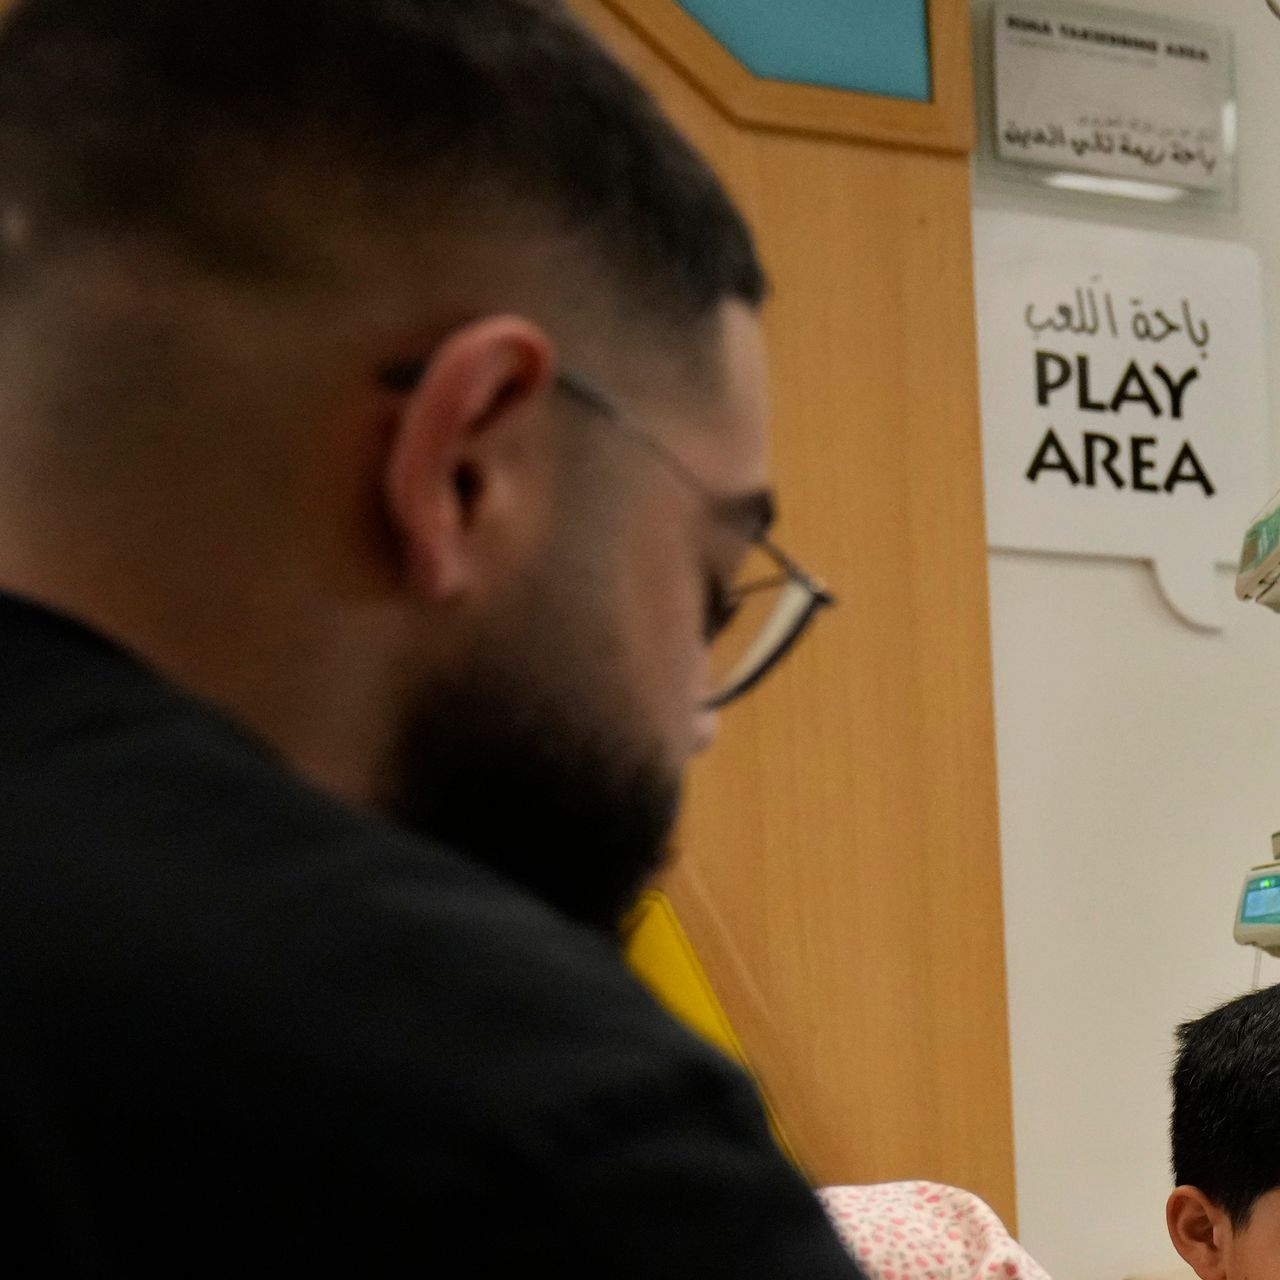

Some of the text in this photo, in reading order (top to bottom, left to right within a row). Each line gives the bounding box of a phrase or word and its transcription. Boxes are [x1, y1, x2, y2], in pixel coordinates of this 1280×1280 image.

[1130, 297, 1210, 359] باحة
[1036, 349, 1199, 420] PLAY
[1026, 427, 1216, 497] AREA
